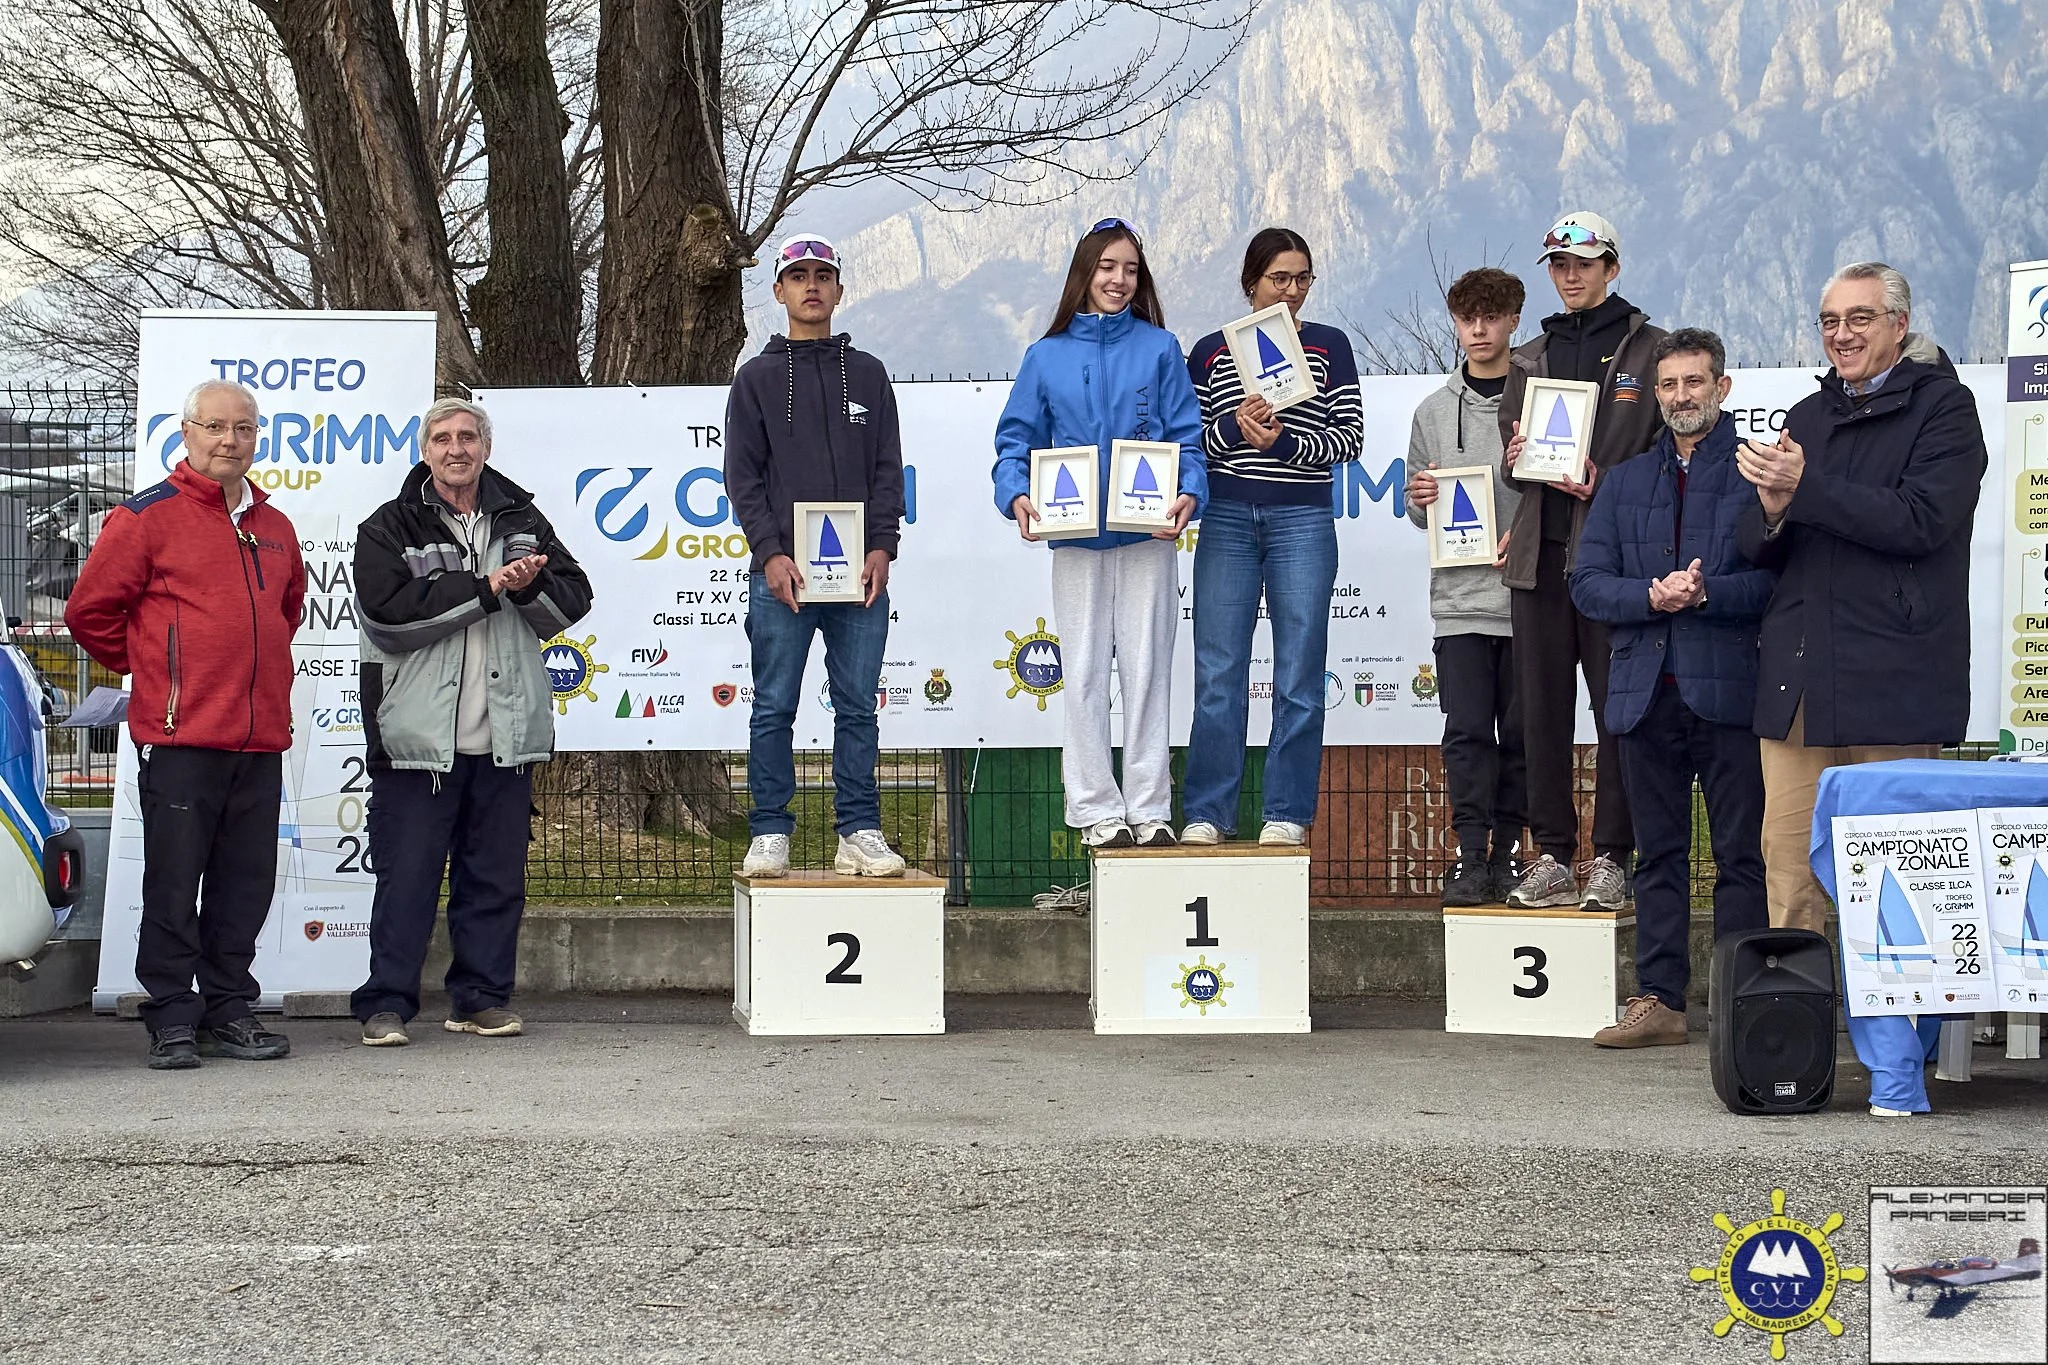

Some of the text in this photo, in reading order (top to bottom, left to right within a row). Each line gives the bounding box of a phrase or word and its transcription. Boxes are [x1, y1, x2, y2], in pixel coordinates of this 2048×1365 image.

[210, 357, 366, 392] TROFEO
[247, 469, 322, 491] ROUP
[709, 569, 728, 583] 22
[676, 591, 705, 605] FIV
[711, 591, 732, 604] XV
[653, 612, 694, 626] Classi
[700, 612, 737, 626] ILCA
[1332, 605, 1370, 619] ILCA
[1377, 604, 1387, 618] 4
[631, 648, 659, 664] FIV
[1011, 634, 1060, 676] CIRCOLO VELICO
[1361, 656, 1394, 664] patrocinio
[1026, 667, 1056, 676] CVT
[888, 687, 912, 695] CONI
[1023, 684, 1062, 694] VALMADRERA
[1375, 683, 1399, 691] CONI
[657, 695, 685, 706] ILCA
[1874, 830, 1897, 838] VELICO
[1898, 829, 1923, 837] TIVANO
[1926, 827, 1968, 835] VALMADRERA
[1845, 836, 1969, 857] CAMPIONATO
[1896, 852, 1971, 872] ZONALE
[1909, 880, 1972, 892] CLASSE ILCA
[1945, 893, 1973, 901] TROFEO
[1185, 896, 1219, 947] 1
[1951, 923, 1977, 941] 22
[1952, 940, 1979, 957] 02
[825, 932, 863, 985] 2
[1954, 957, 1981, 975] 26
[1513, 945, 1550, 999] 3
